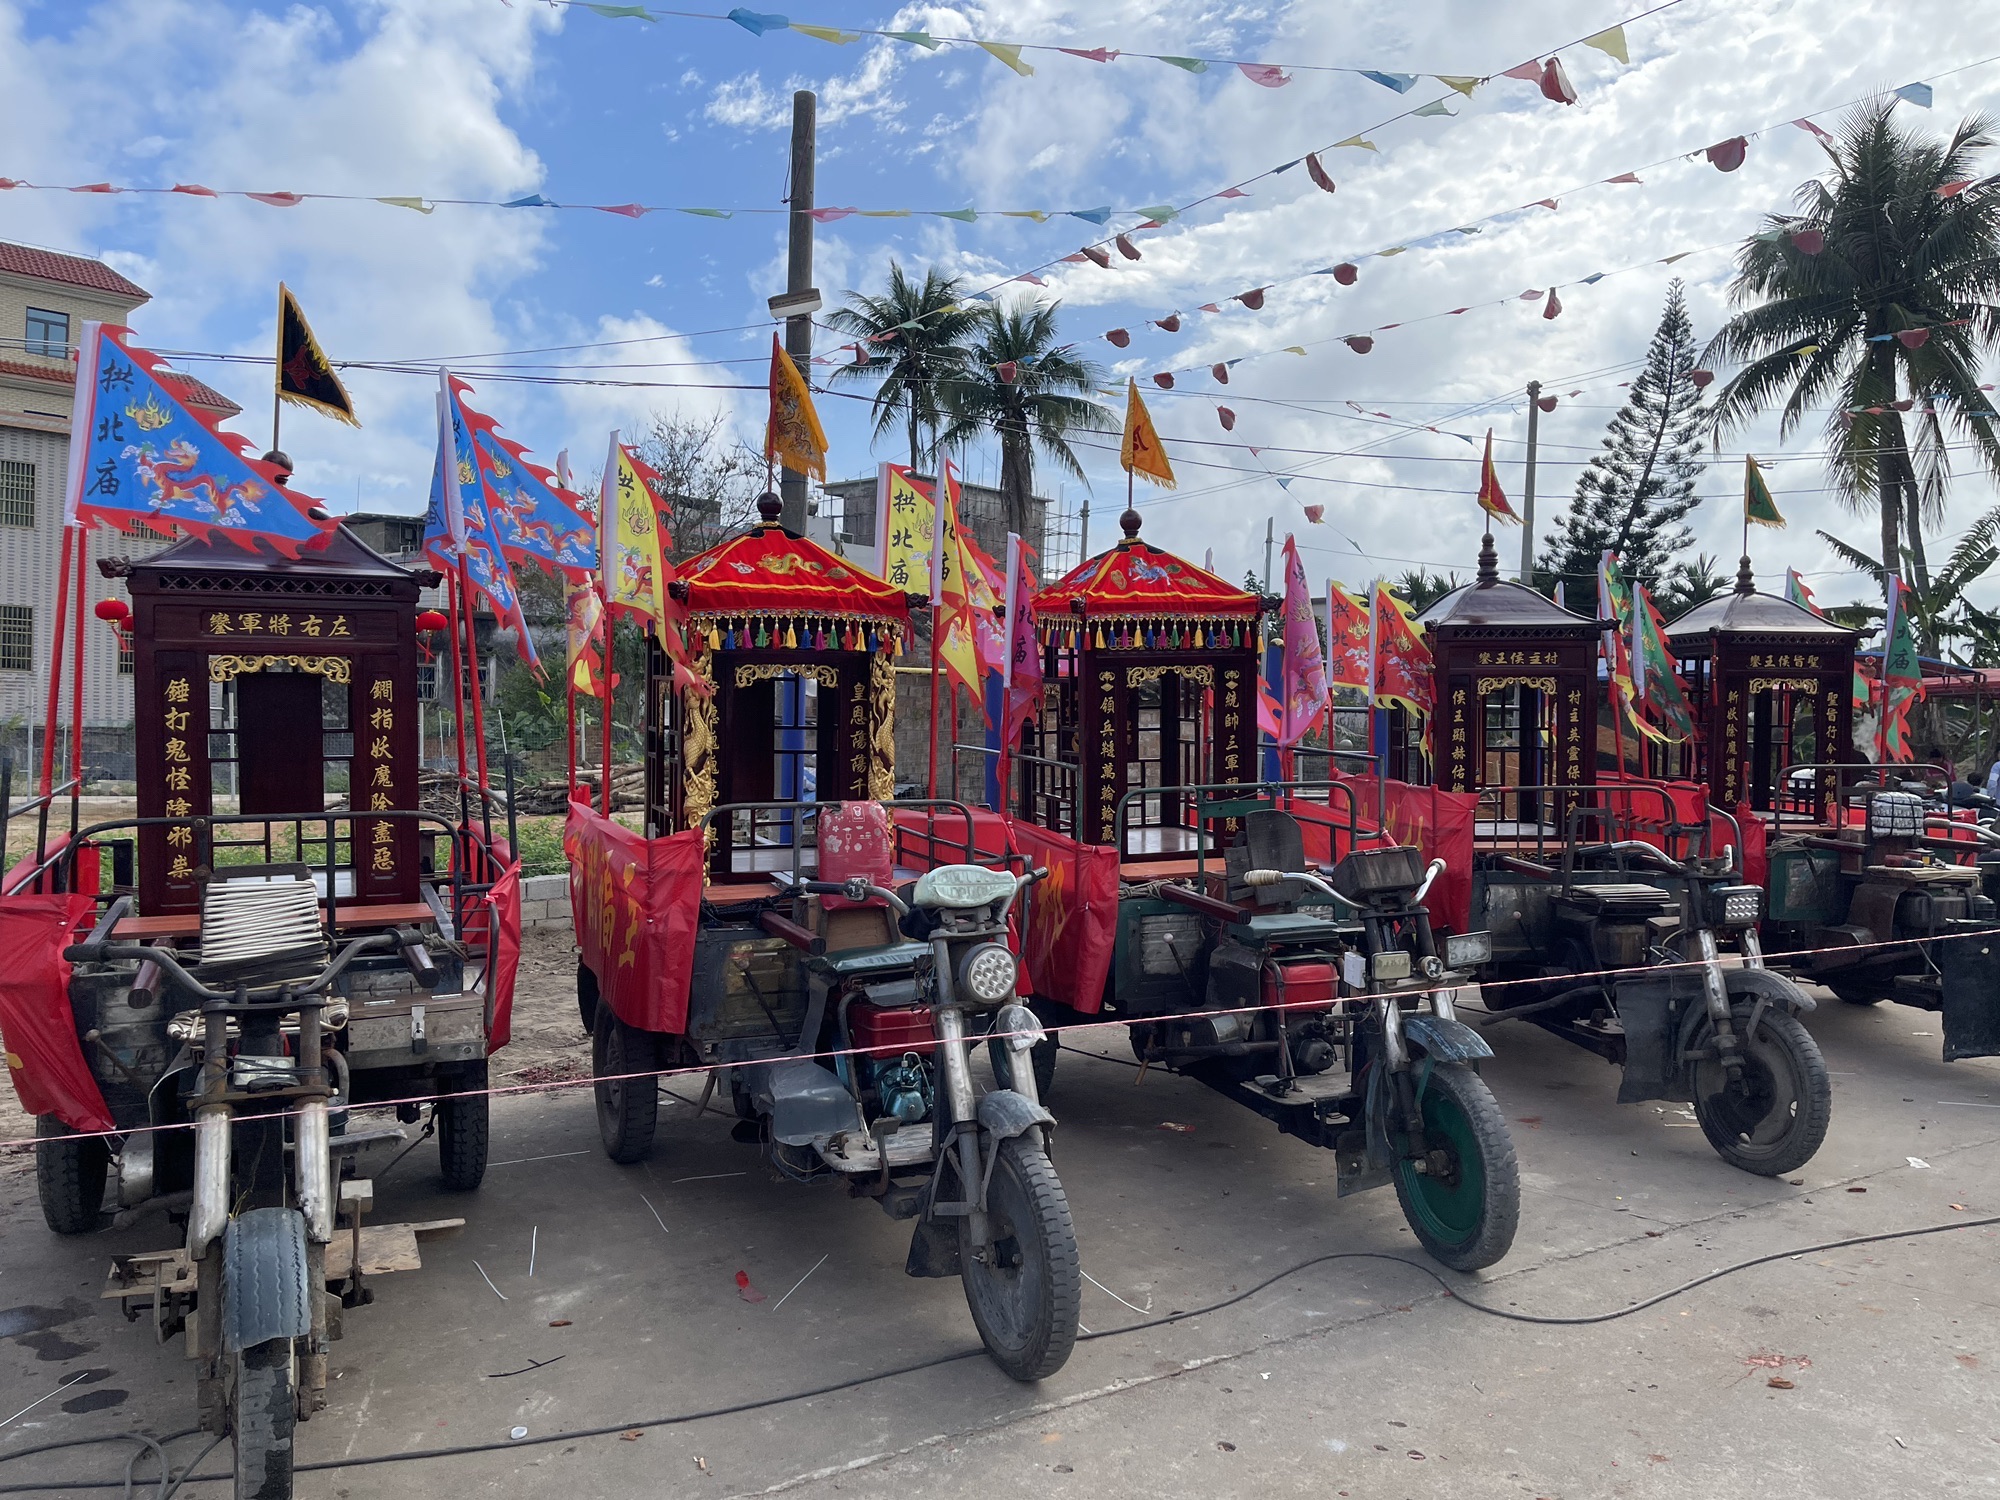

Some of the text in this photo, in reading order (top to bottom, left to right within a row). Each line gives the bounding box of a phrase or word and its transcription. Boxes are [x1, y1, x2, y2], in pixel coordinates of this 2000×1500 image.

[87, 358, 134, 497] 拱北庙
[889, 488, 917, 586] 拱北庙
[1333, 600, 1350, 676] 拱北庙
[1375, 605, 1396, 689] 拱北庙
